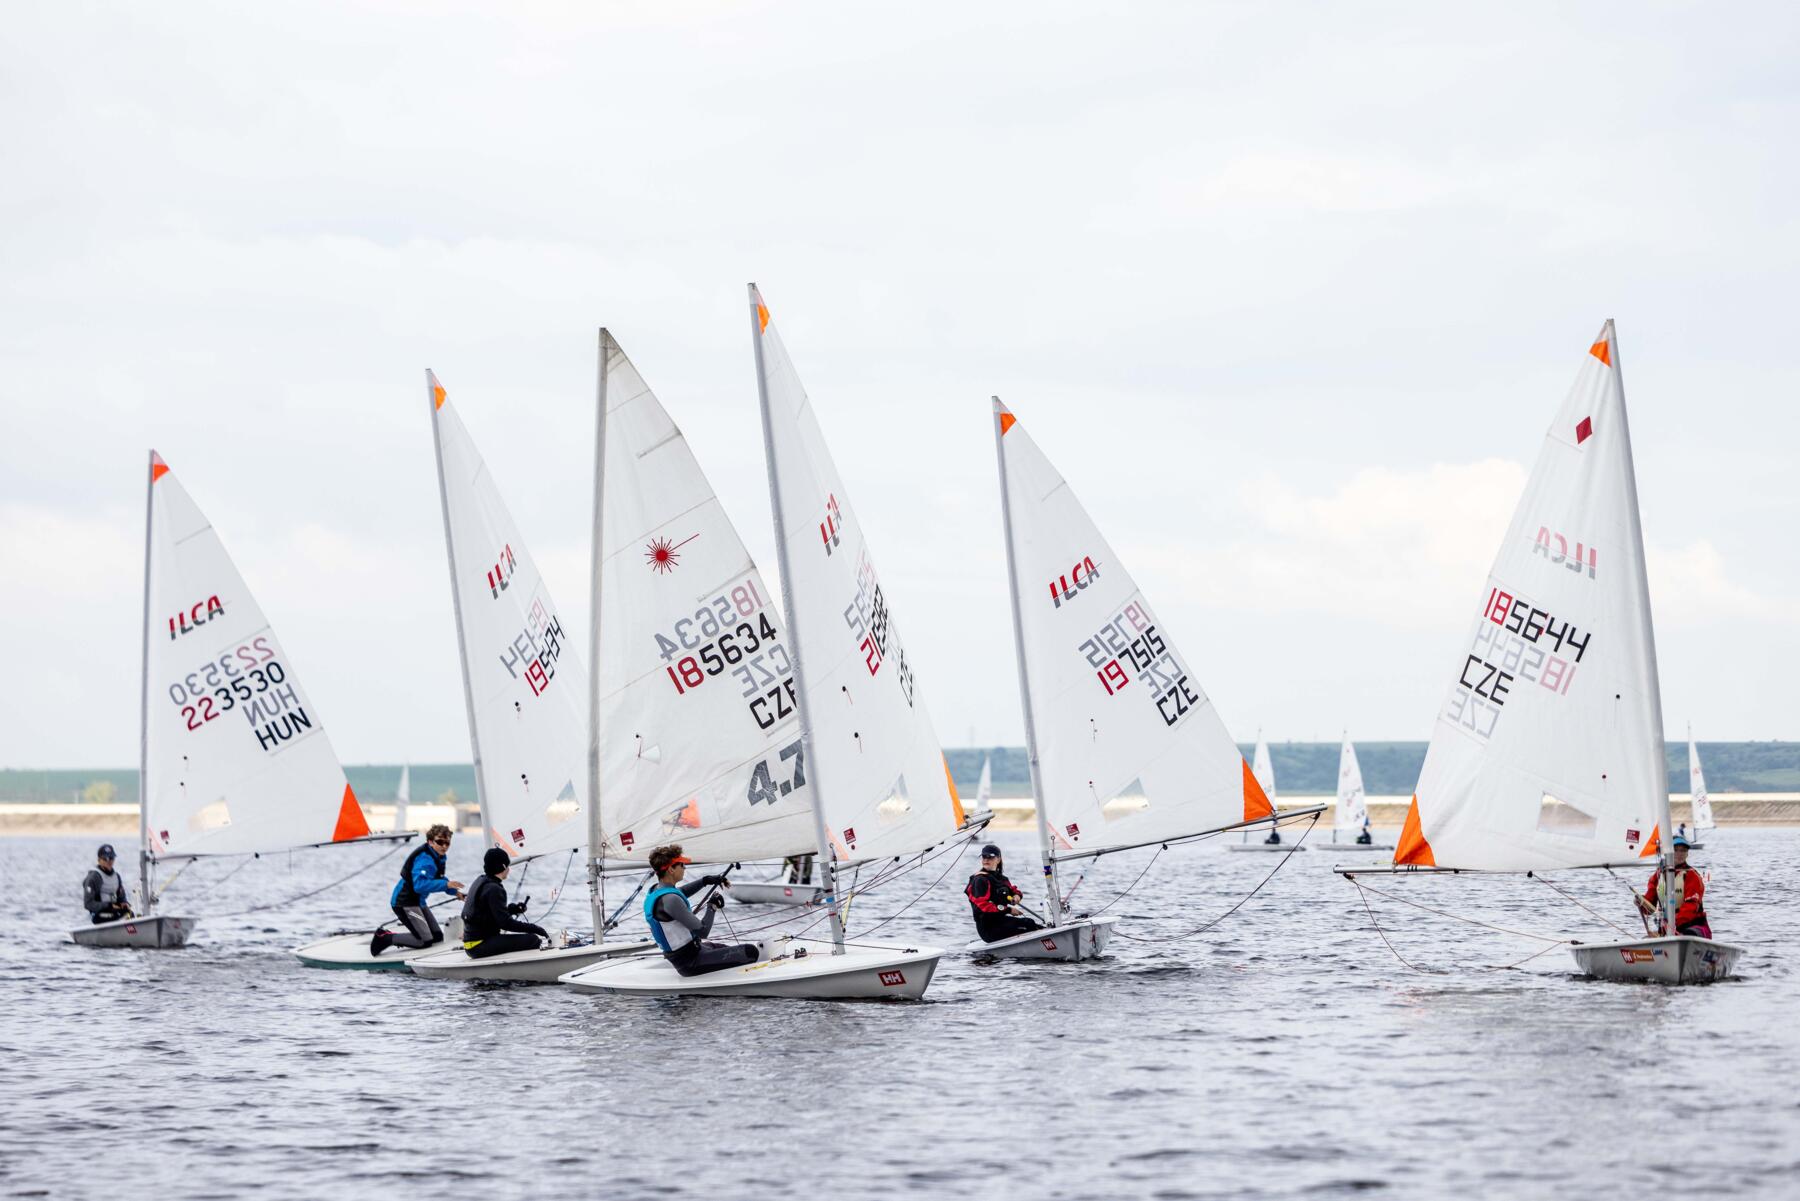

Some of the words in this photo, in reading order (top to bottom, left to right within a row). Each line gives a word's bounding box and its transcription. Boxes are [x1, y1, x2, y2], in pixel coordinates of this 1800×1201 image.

[487, 543, 517, 600] ILCA
[1049, 556, 1100, 609] ILCA
[169, 595, 225, 640] ILCA
[1484, 587, 1591, 663] 185644
[667, 612, 777, 695] 185634
[1097, 625, 1167, 696] 197515
[1459, 654, 1514, 706] CZE
[181, 661, 285, 731] 223530
[1156, 675, 1199, 727] CZE
[255, 707, 312, 752] HUN
[747, 738, 807, 807] 4.7
